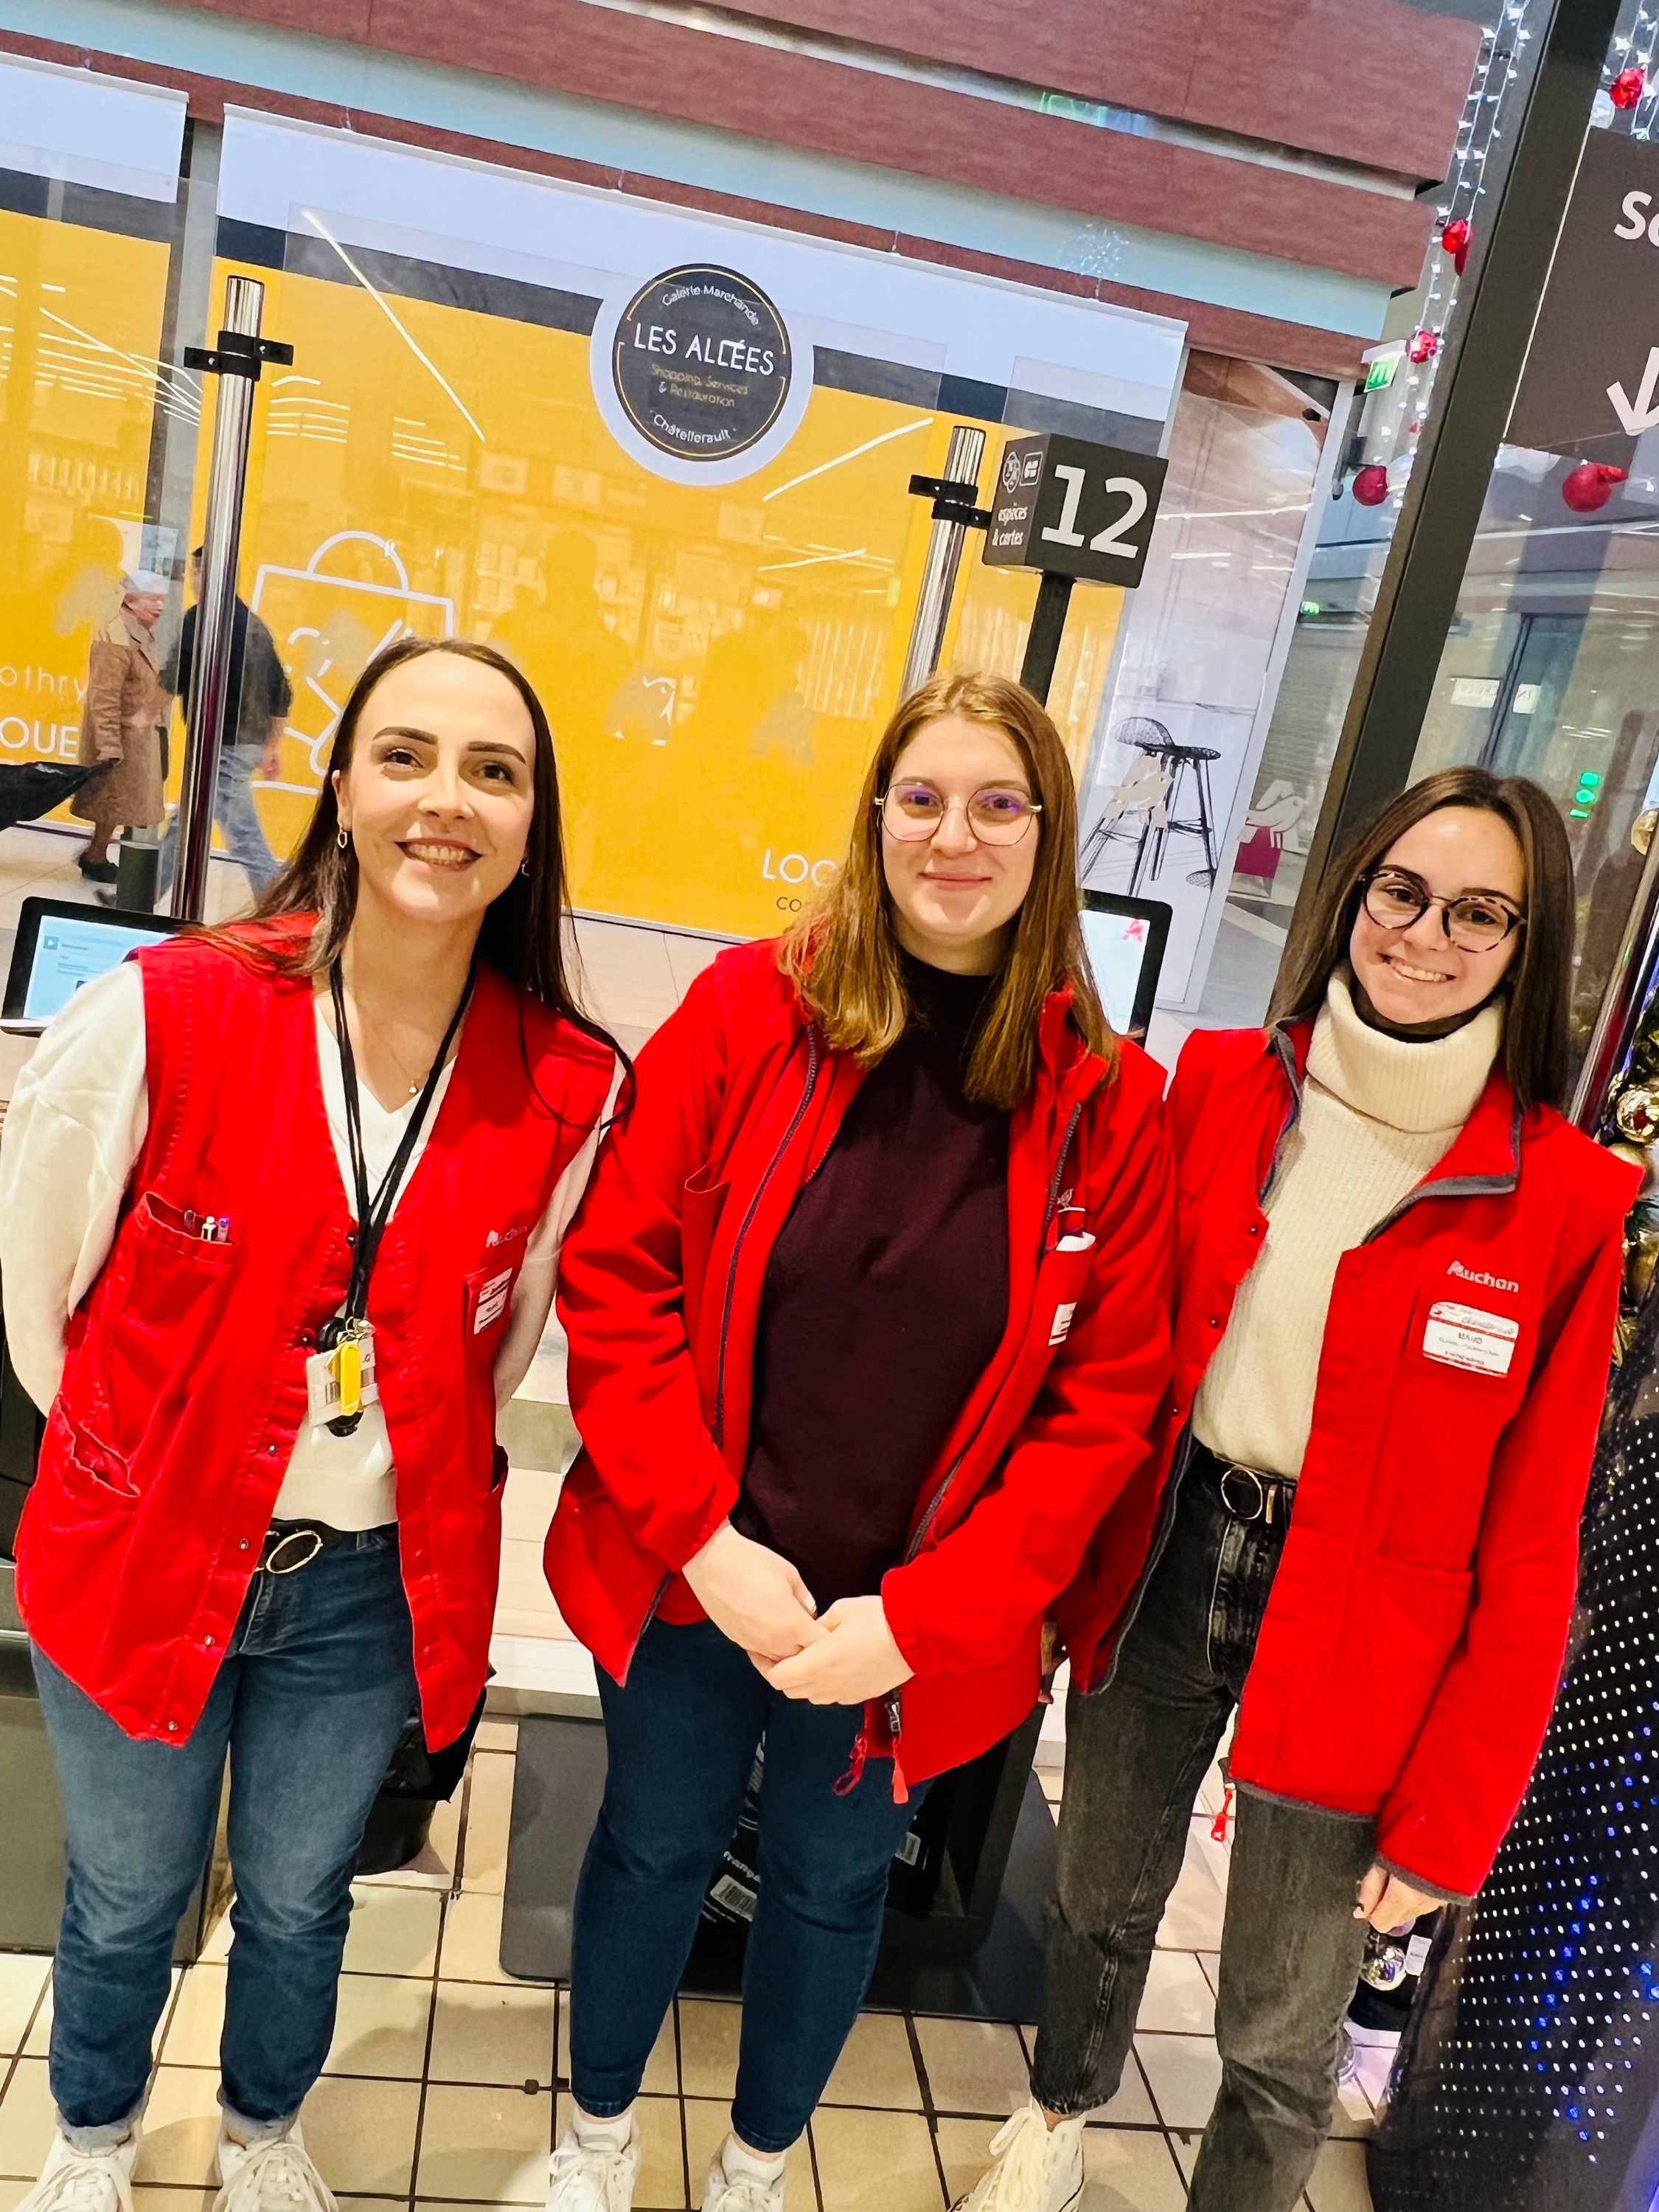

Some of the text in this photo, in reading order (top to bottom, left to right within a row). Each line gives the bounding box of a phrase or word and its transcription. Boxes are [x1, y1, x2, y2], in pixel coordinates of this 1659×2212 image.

[703, 285, 760, 327] Marchande
[633, 322, 775, 376] LES ALLÉES
[669, 383, 735, 407] Restauration
[1041, 464, 1148, 559] 12
[0, 717, 78, 758] OUE
[1446, 1259, 1520, 1293] Auchan
